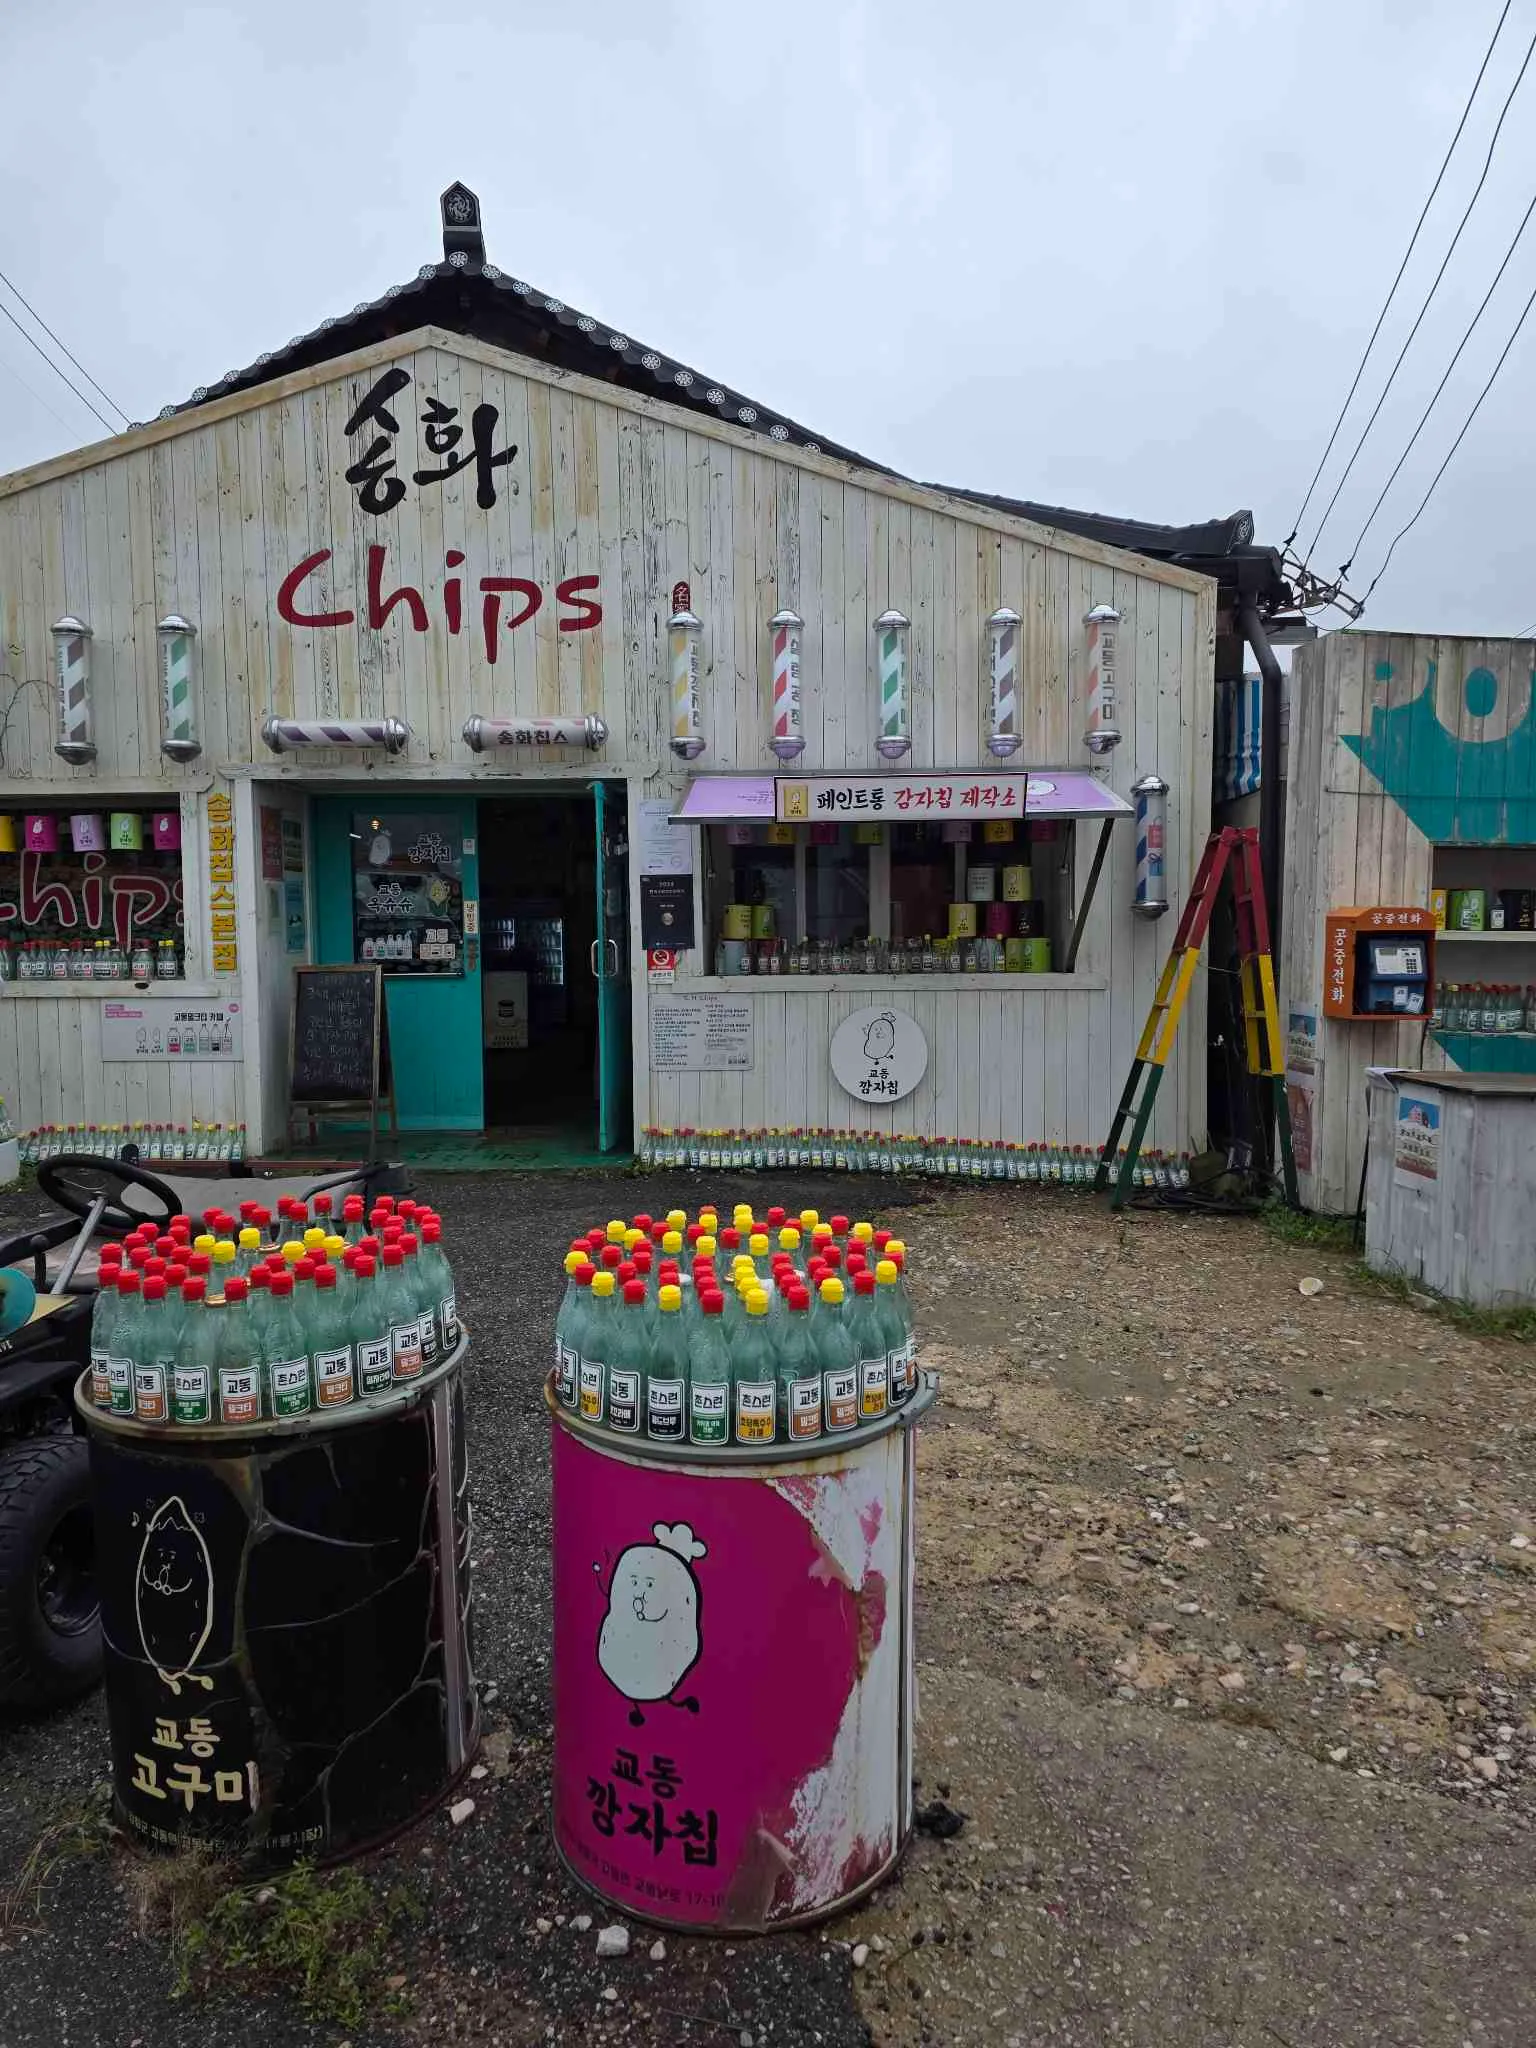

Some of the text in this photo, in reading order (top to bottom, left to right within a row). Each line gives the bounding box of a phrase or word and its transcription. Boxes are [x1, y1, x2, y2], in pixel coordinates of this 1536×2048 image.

[344, 367, 518, 516] 송화
[277, 545, 603, 664] Chips
[1361, 638, 1536, 743] PO
[498, 729, 569, 746] 송화칩스
[816, 786, 886, 811] 페인트통
[893, 787, 953, 811] 감자칩
[960, 785, 1017, 809] 제작소
[208, 793, 237, 970] 송화칩스본점
[377, 882, 401, 896] 교동
[0, 849, 184, 952] hip
[367, 897, 415, 914] 옥슈슈
[1370, 911, 1423, 926] 공중전화
[1330, 928, 1347, 1005] 공중전화
[868, 1068, 890, 1080] 교동
[400, 1331, 419, 1349] 교동
[368, 1347, 389, 1366] 교동
[324, 1359, 347, 1376] 교동
[227, 1378, 251, 1393] 교동
[835, 1379, 856, 1397] 교동
[694, 1393, 724, 1409] 촌스런
[741, 1393, 772, 1408] 촌스런
[799, 1386, 819, 1406] 교동
[152, 1716, 221, 1758] 교동
[611, 1747, 684, 1799] 교동
[131, 1752, 261, 1814] 고구미
